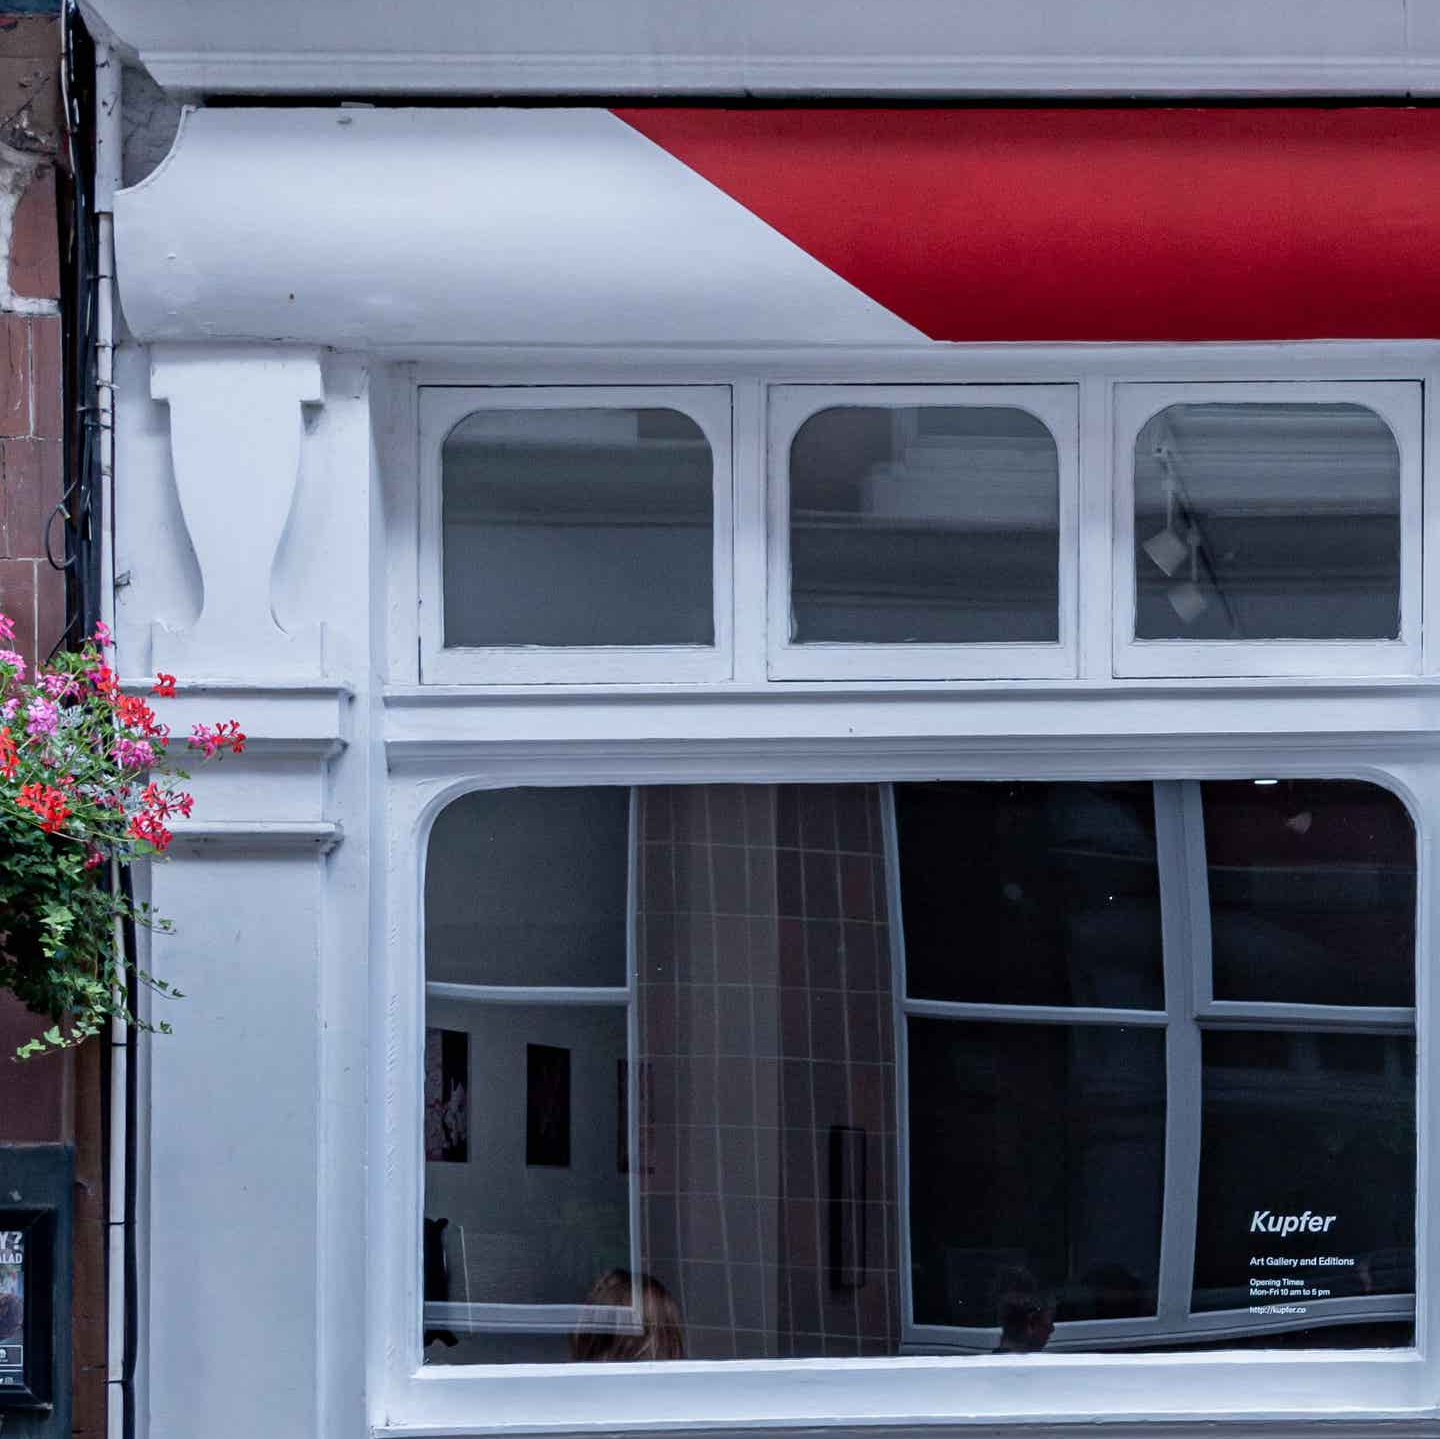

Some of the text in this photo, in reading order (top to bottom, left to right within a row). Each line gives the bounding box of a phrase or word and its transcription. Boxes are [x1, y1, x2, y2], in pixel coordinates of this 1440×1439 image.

[1250, 1211, 1336, 1237] Kupfer
[1249, 1257, 1354, 1268] Art Gallery and Editions
[1249, 1278, 1304, 1287] Opening Times
[1249, 1288, 1279, 1296] Mon-Fri
[1280, 1288, 1288, 1296] 10
